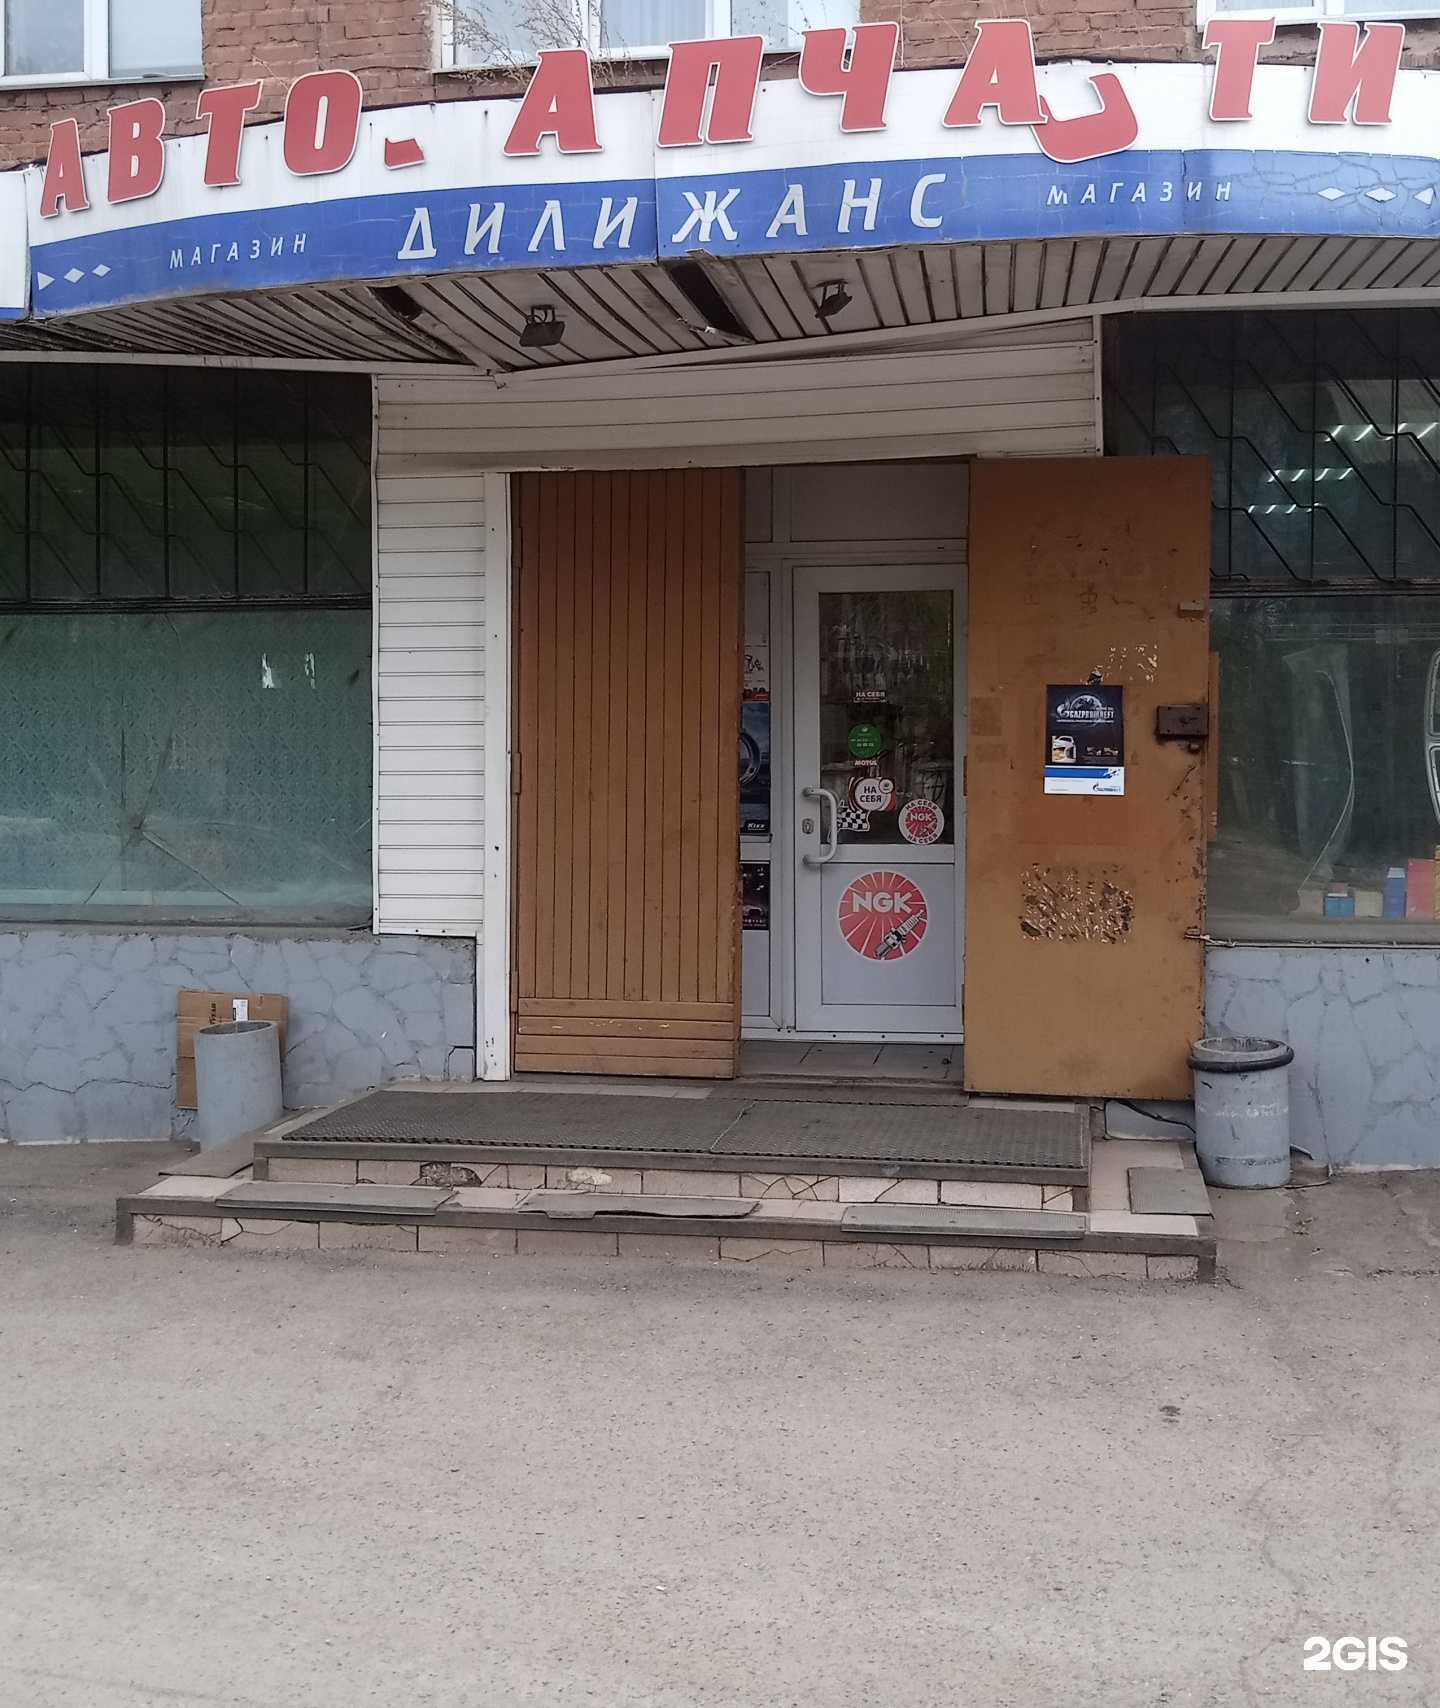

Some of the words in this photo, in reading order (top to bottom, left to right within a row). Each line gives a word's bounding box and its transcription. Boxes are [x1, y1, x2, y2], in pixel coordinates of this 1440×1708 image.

[1046, 180, 1233, 206] МАГАЗИН
[397, 173, 946, 261] ДИЛИЖАНС
[169, 233, 308, 269] МАГАЗИН
[859, 795, 882, 803] СЕБЯ
[863, 786, 877, 794] НА
[910, 812, 932, 821] NGK
[852, 891, 914, 913] NGK
